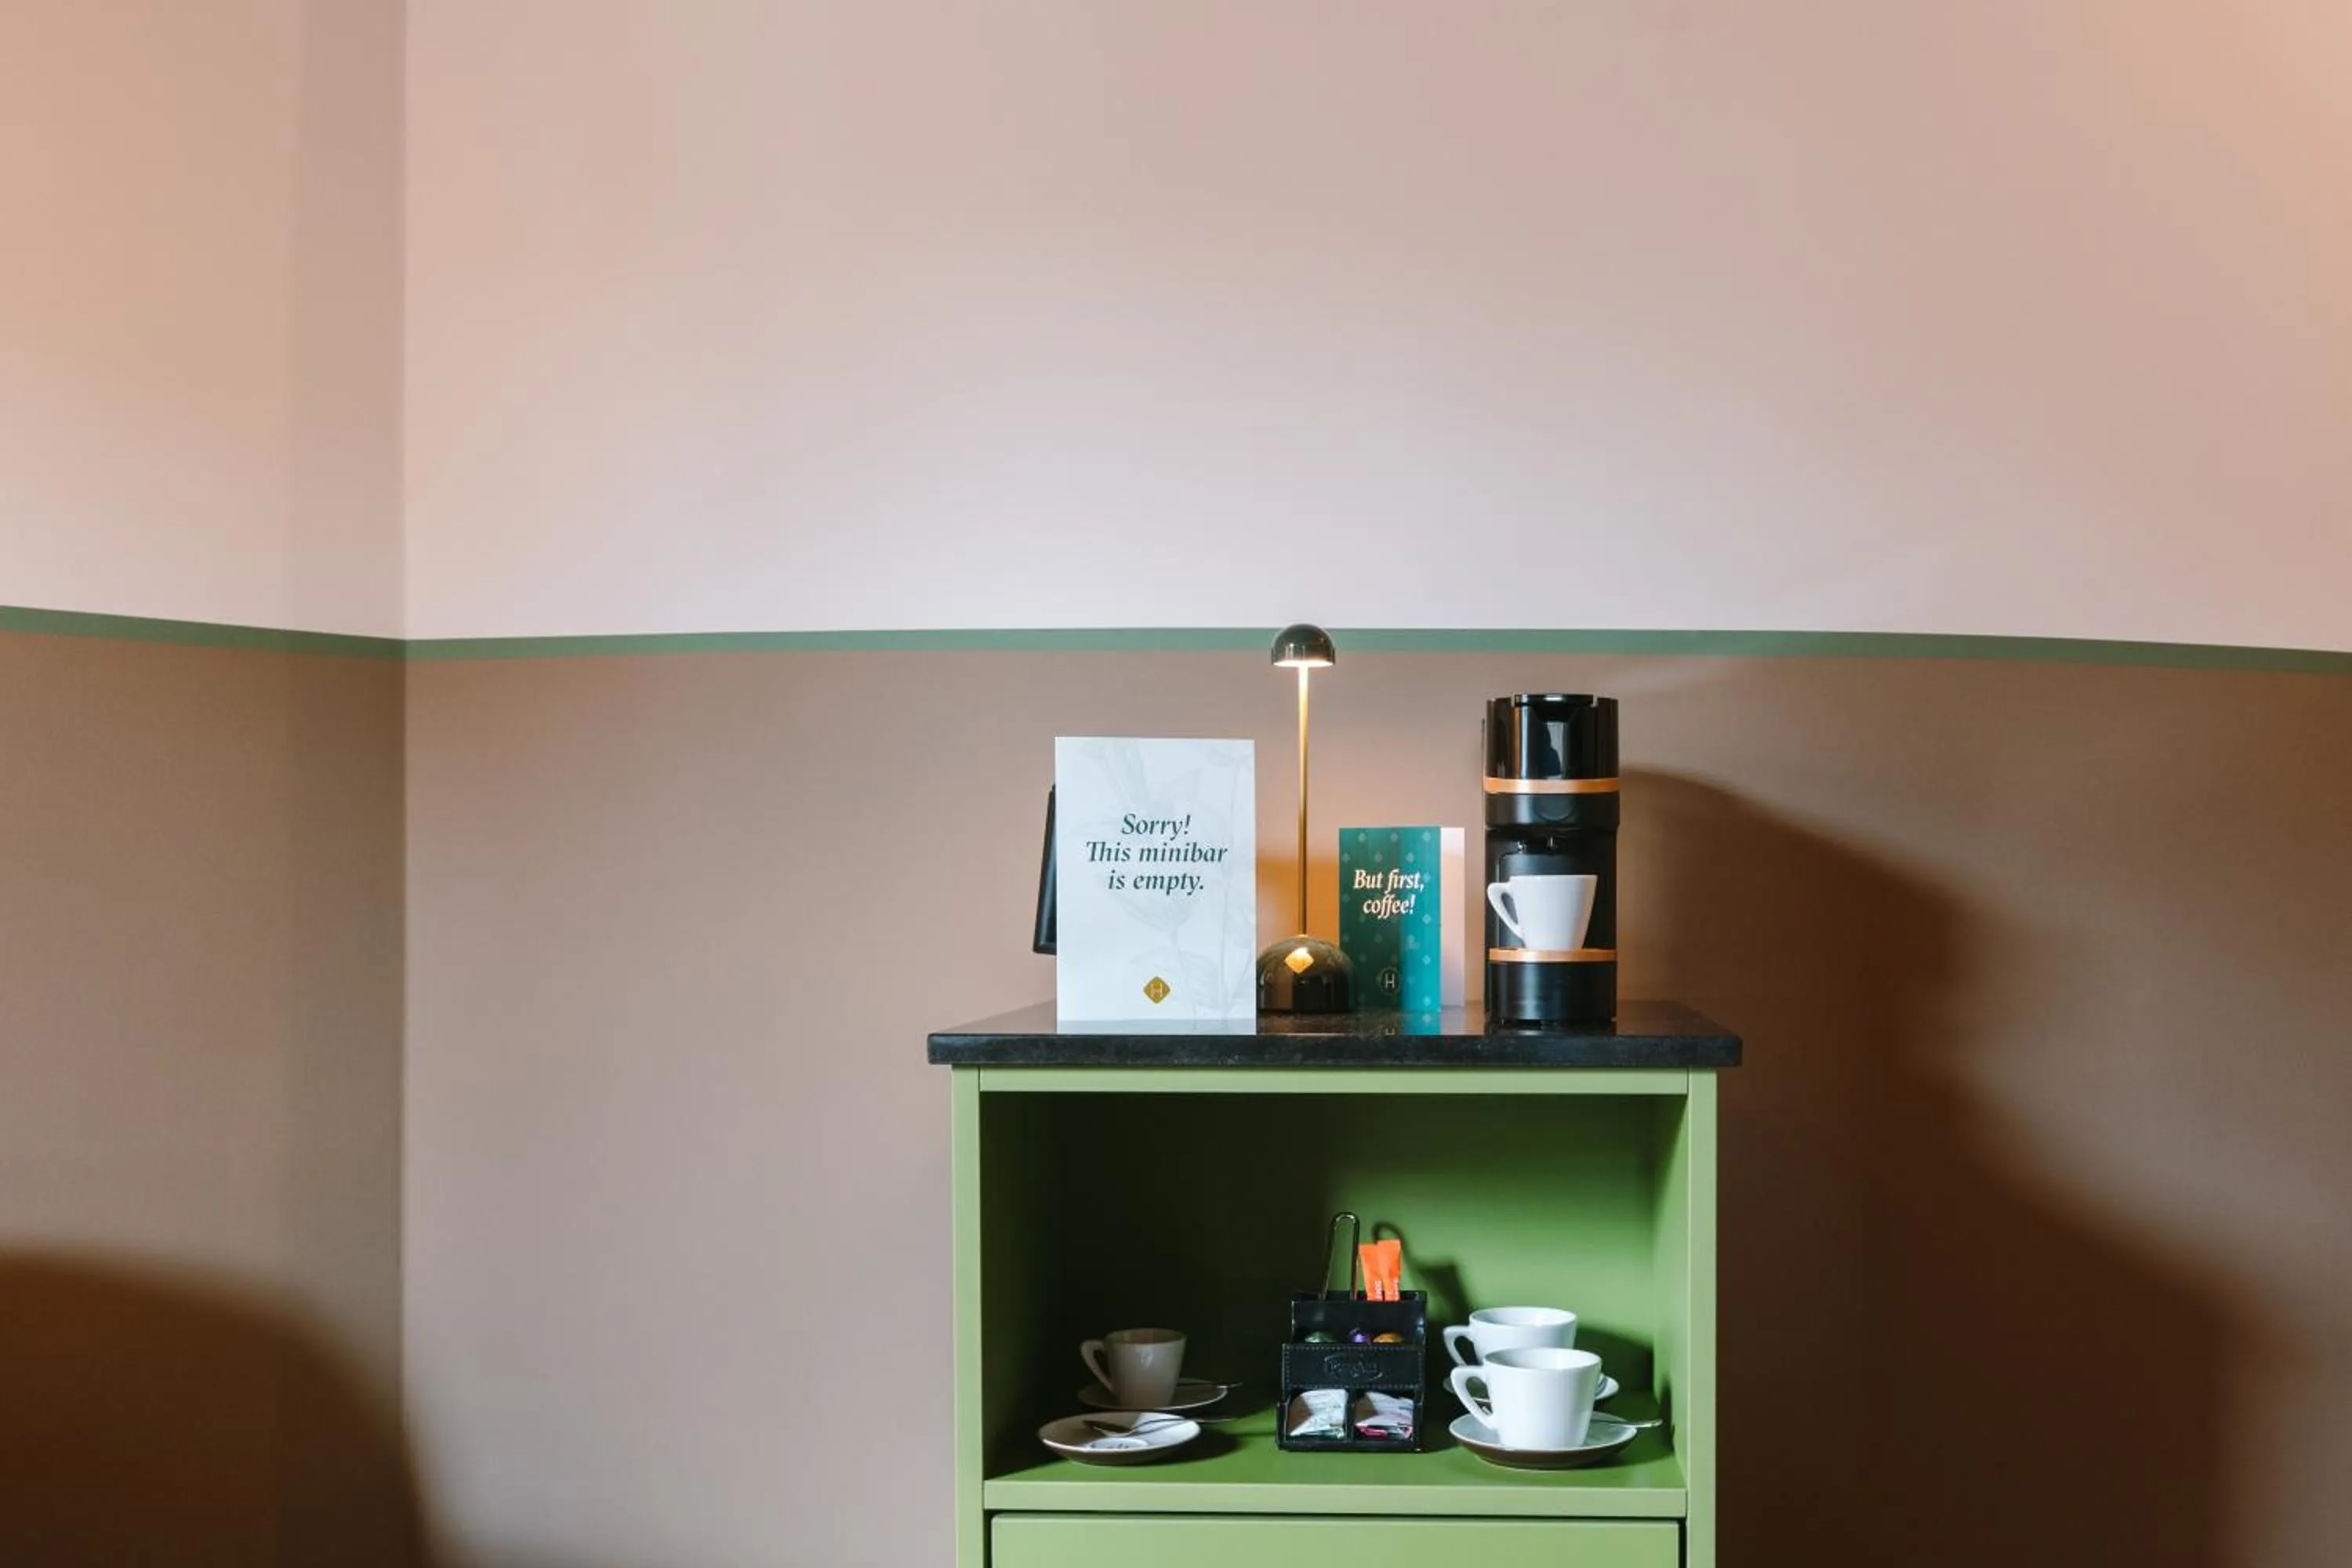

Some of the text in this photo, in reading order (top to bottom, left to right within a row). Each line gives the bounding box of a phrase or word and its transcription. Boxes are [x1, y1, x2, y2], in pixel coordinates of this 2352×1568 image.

[1121, 813, 1191, 840] Sorry!
[1087, 840, 1229, 863] This minibar
[1107, 869, 1204, 896] is empty.
[1353, 868, 1425, 894] But first,
[1363, 894, 1417, 920] coffee!
